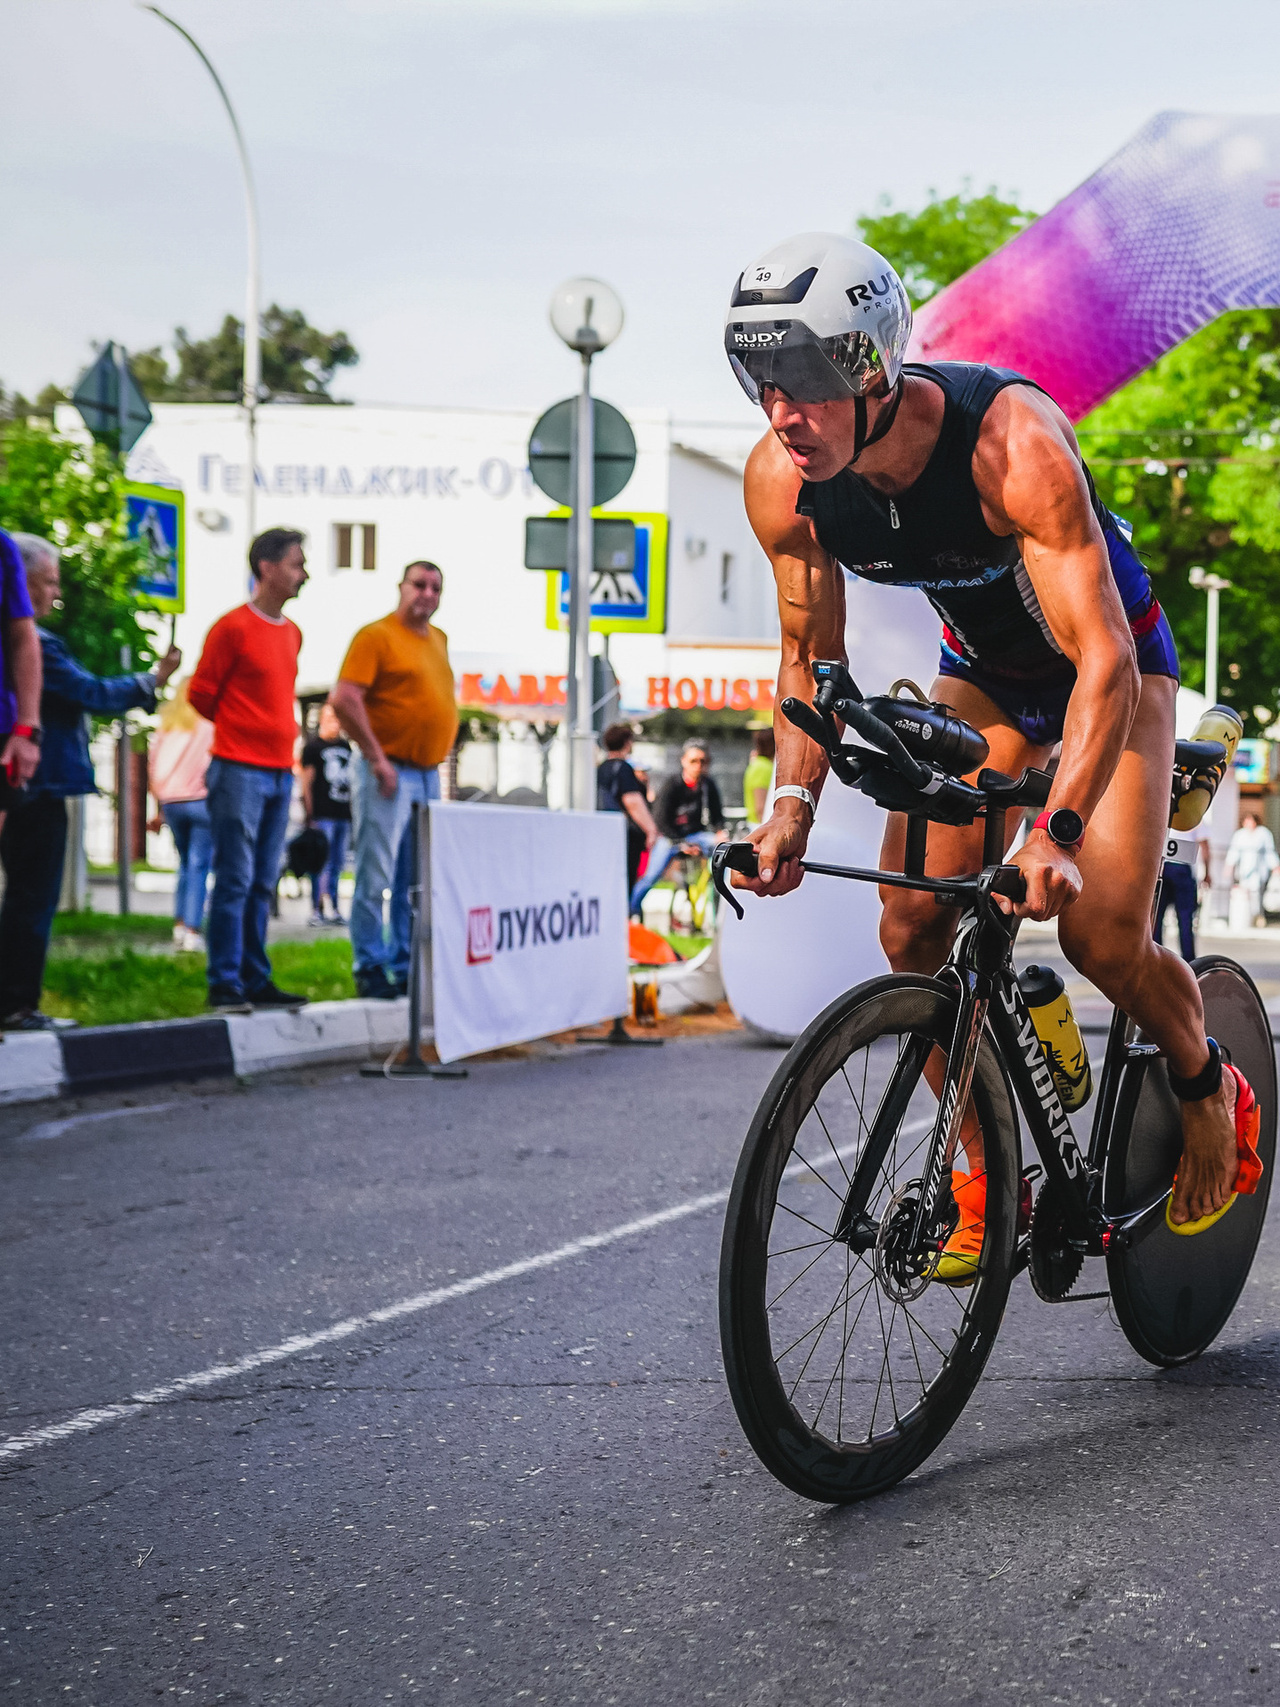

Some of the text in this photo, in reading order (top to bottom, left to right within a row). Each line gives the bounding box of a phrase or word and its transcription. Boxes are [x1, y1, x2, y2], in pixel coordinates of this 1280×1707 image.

[755, 271, 772, 282] 49
[845, 270, 900, 307] RUD
[734, 330, 788, 344] RUDY
[647, 676, 775, 711] HOUSE
[496, 890, 599, 951] ЛУКОЙЛ
[999, 981, 1085, 1180] S-WORKS
[925, 1079, 958, 1219] SPECIALIZED
